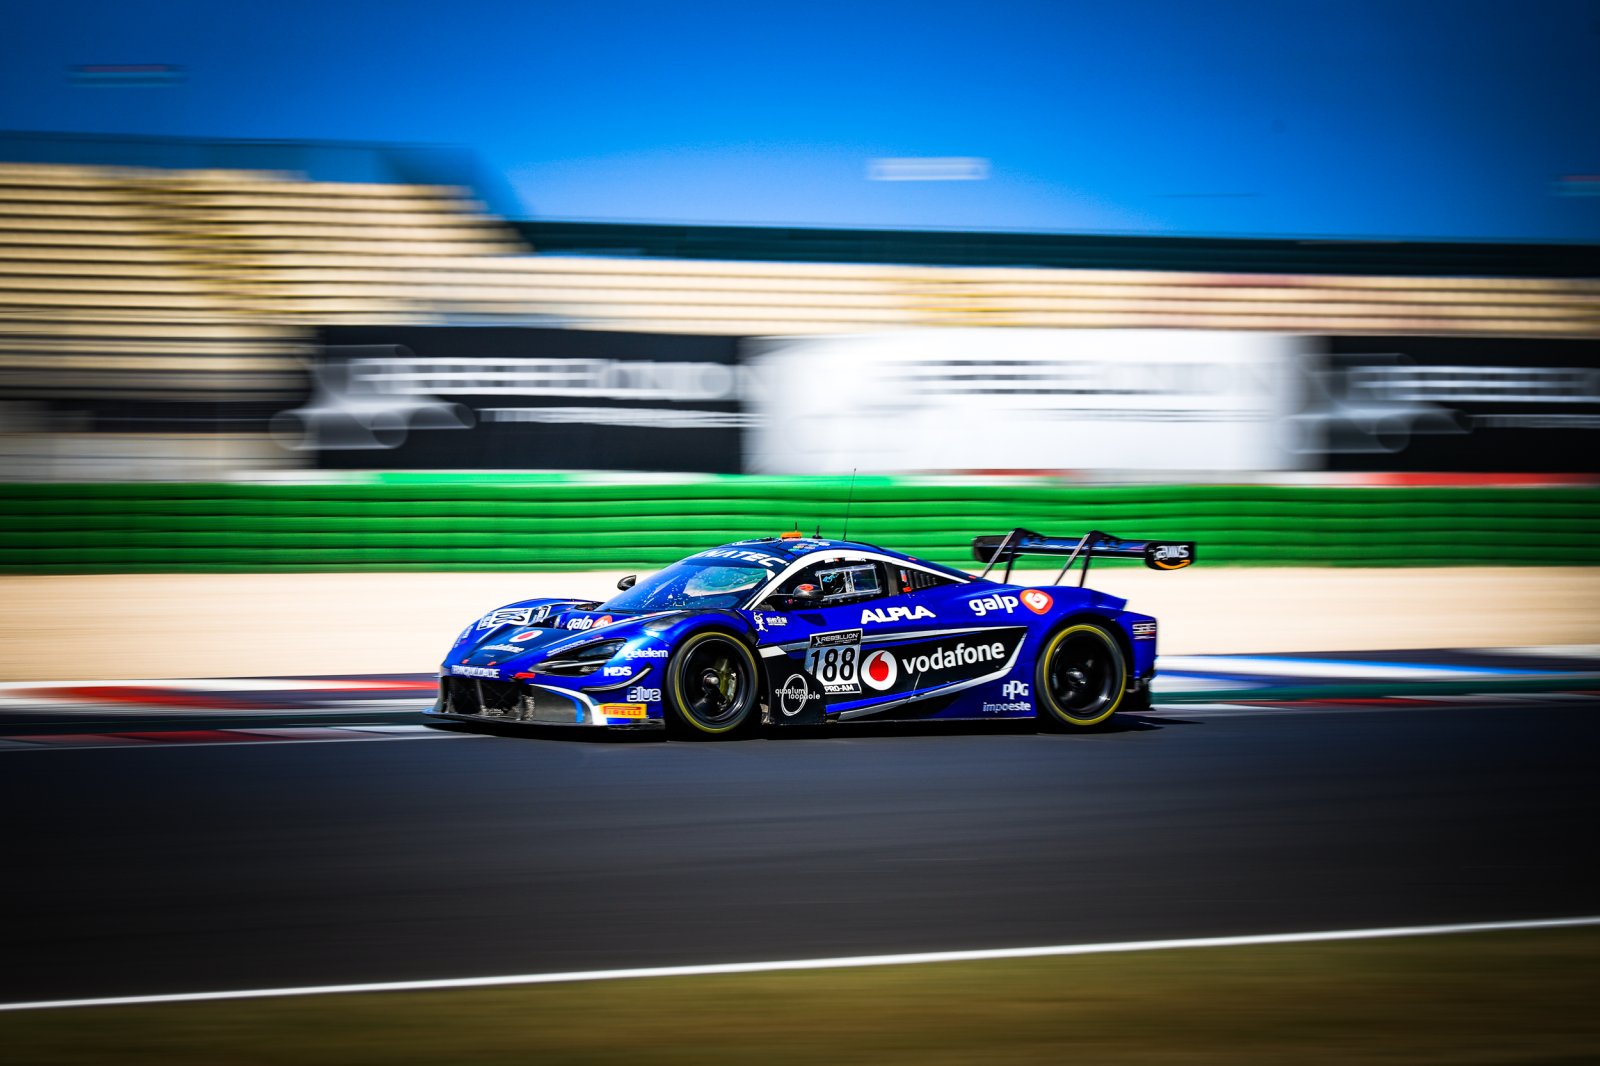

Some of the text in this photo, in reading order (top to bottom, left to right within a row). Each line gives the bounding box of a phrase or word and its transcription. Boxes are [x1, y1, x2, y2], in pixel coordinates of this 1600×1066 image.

[968, 594, 1019, 616] galp
[860, 605, 936, 624] ALPLA
[811, 648, 855, 682] 188
[902, 642, 1006, 674] vodafone
[603, 666, 632, 677] MDS
[626, 686, 661, 702] Blue
[775, 686, 804, 697] quantum
[824, 684, 854, 692] PRO-AM
[1002, 680, 1029, 699] PPG
[603, 705, 642, 716] PIRELLI
[983, 701, 1031, 713] impoeste
